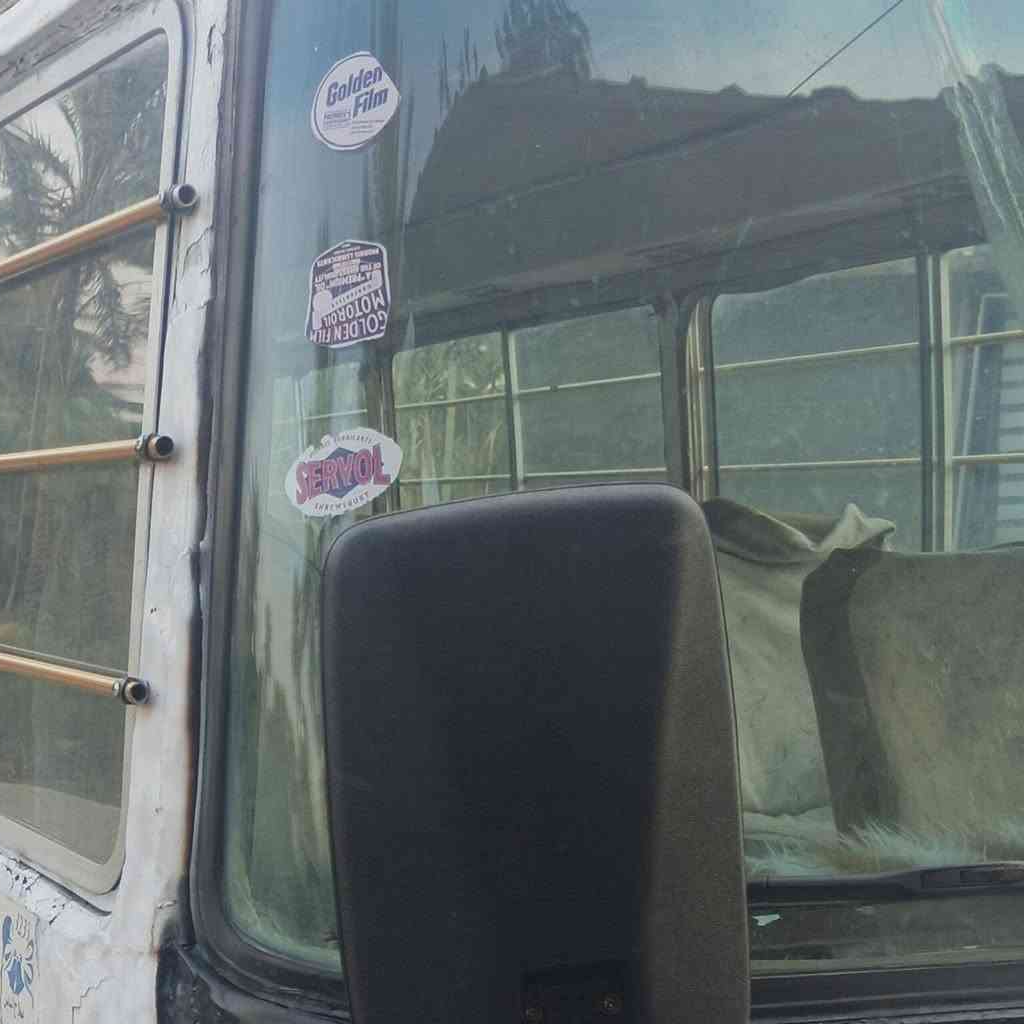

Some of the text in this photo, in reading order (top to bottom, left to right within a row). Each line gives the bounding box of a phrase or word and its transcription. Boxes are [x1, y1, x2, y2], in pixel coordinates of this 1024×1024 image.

[326, 66, 383, 106] Golden
[352, 88, 389, 119] Film
[337, 289, 385, 320] MOTOR
[309, 310, 387, 343] GOLDEN FILM
[295, 442, 391, 505] SERVOL
